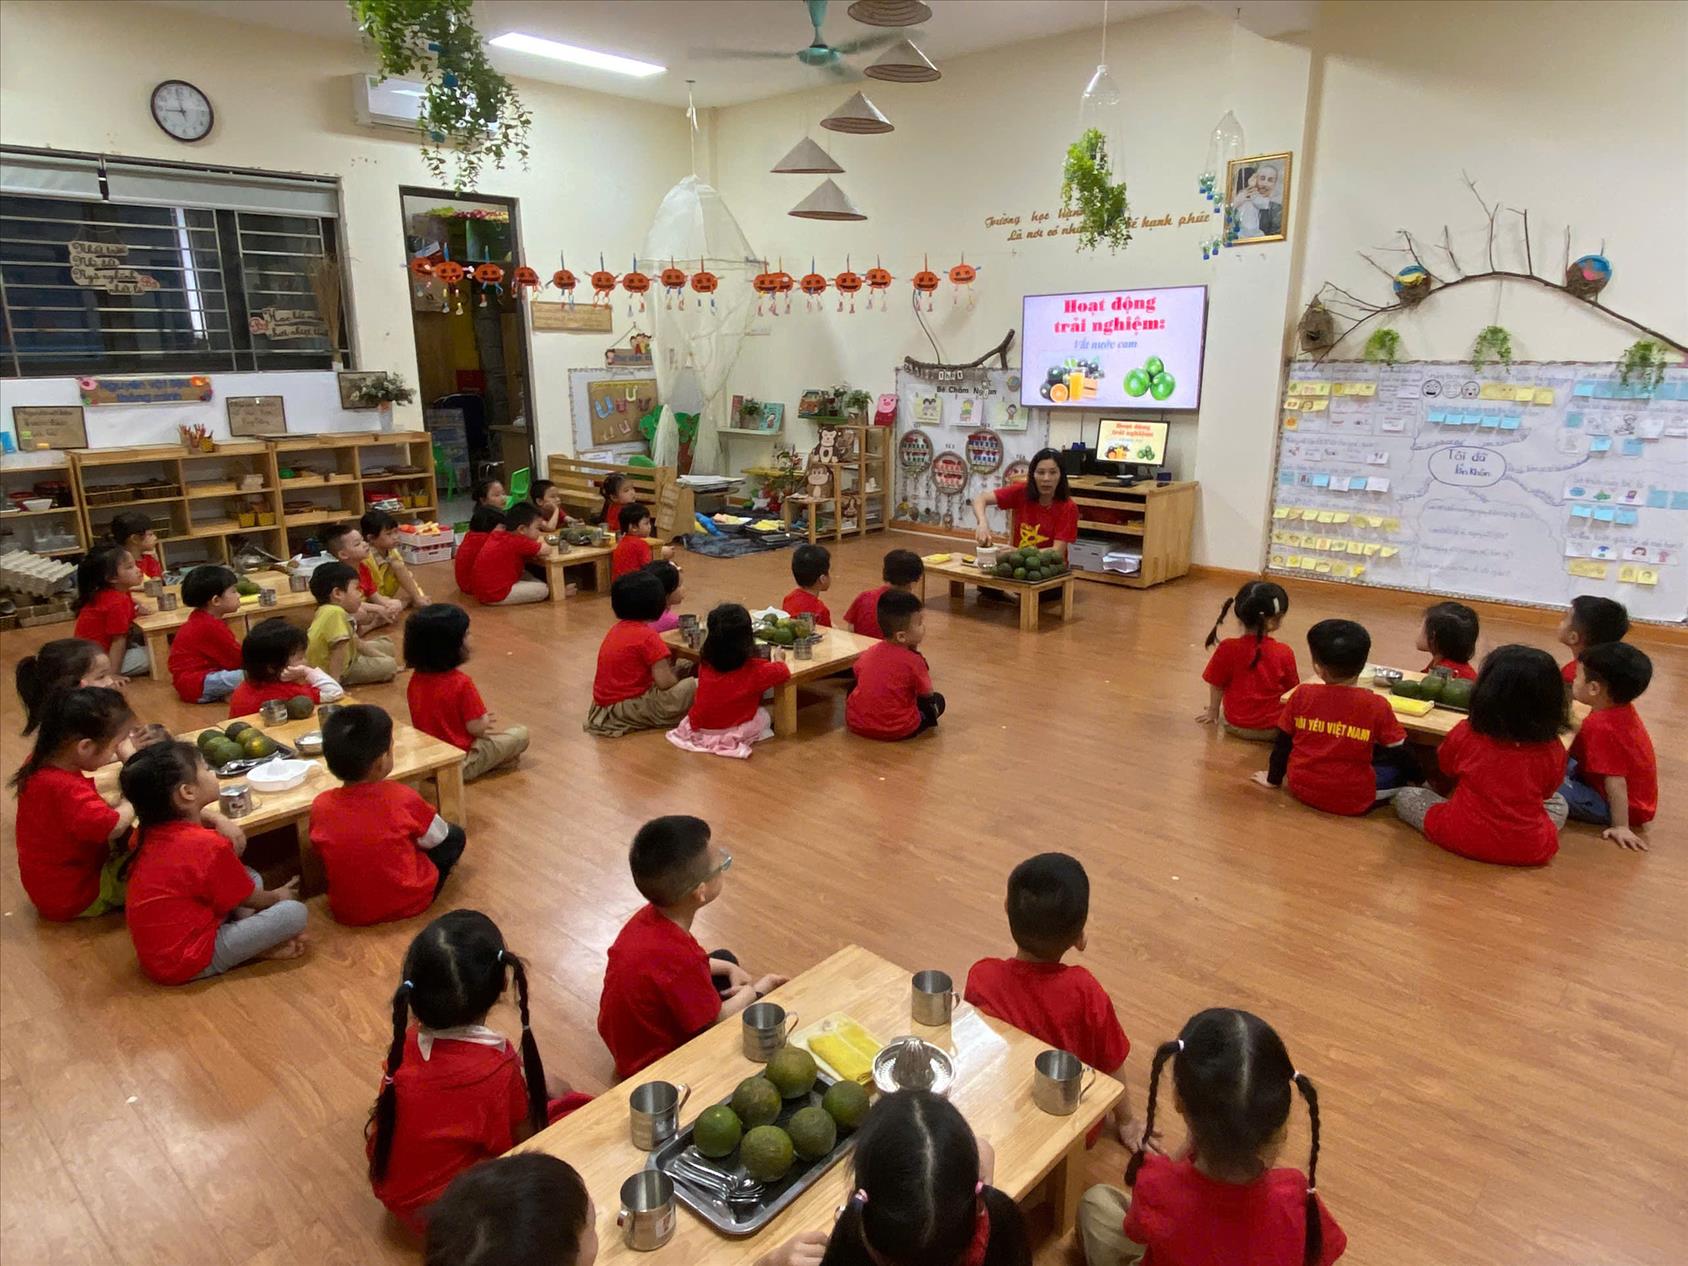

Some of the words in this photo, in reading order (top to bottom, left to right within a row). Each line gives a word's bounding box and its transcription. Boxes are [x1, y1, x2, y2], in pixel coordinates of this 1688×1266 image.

[1179, 211, 1210, 228] phúc
[1064, 297, 1105, 316] Hoạt
[1111, 296, 1157, 314] động
[1054, 317, 1086, 333] trải
[1092, 316, 1165, 336] nghiệm:
[1117, 340, 1138, 348] cam
[973, 387, 997, 397] Ngan
[1447, 449, 1467, 461] Tôi
[1327, 721, 1347, 738] VIỆT
[1347, 725, 1371, 742] NAM
